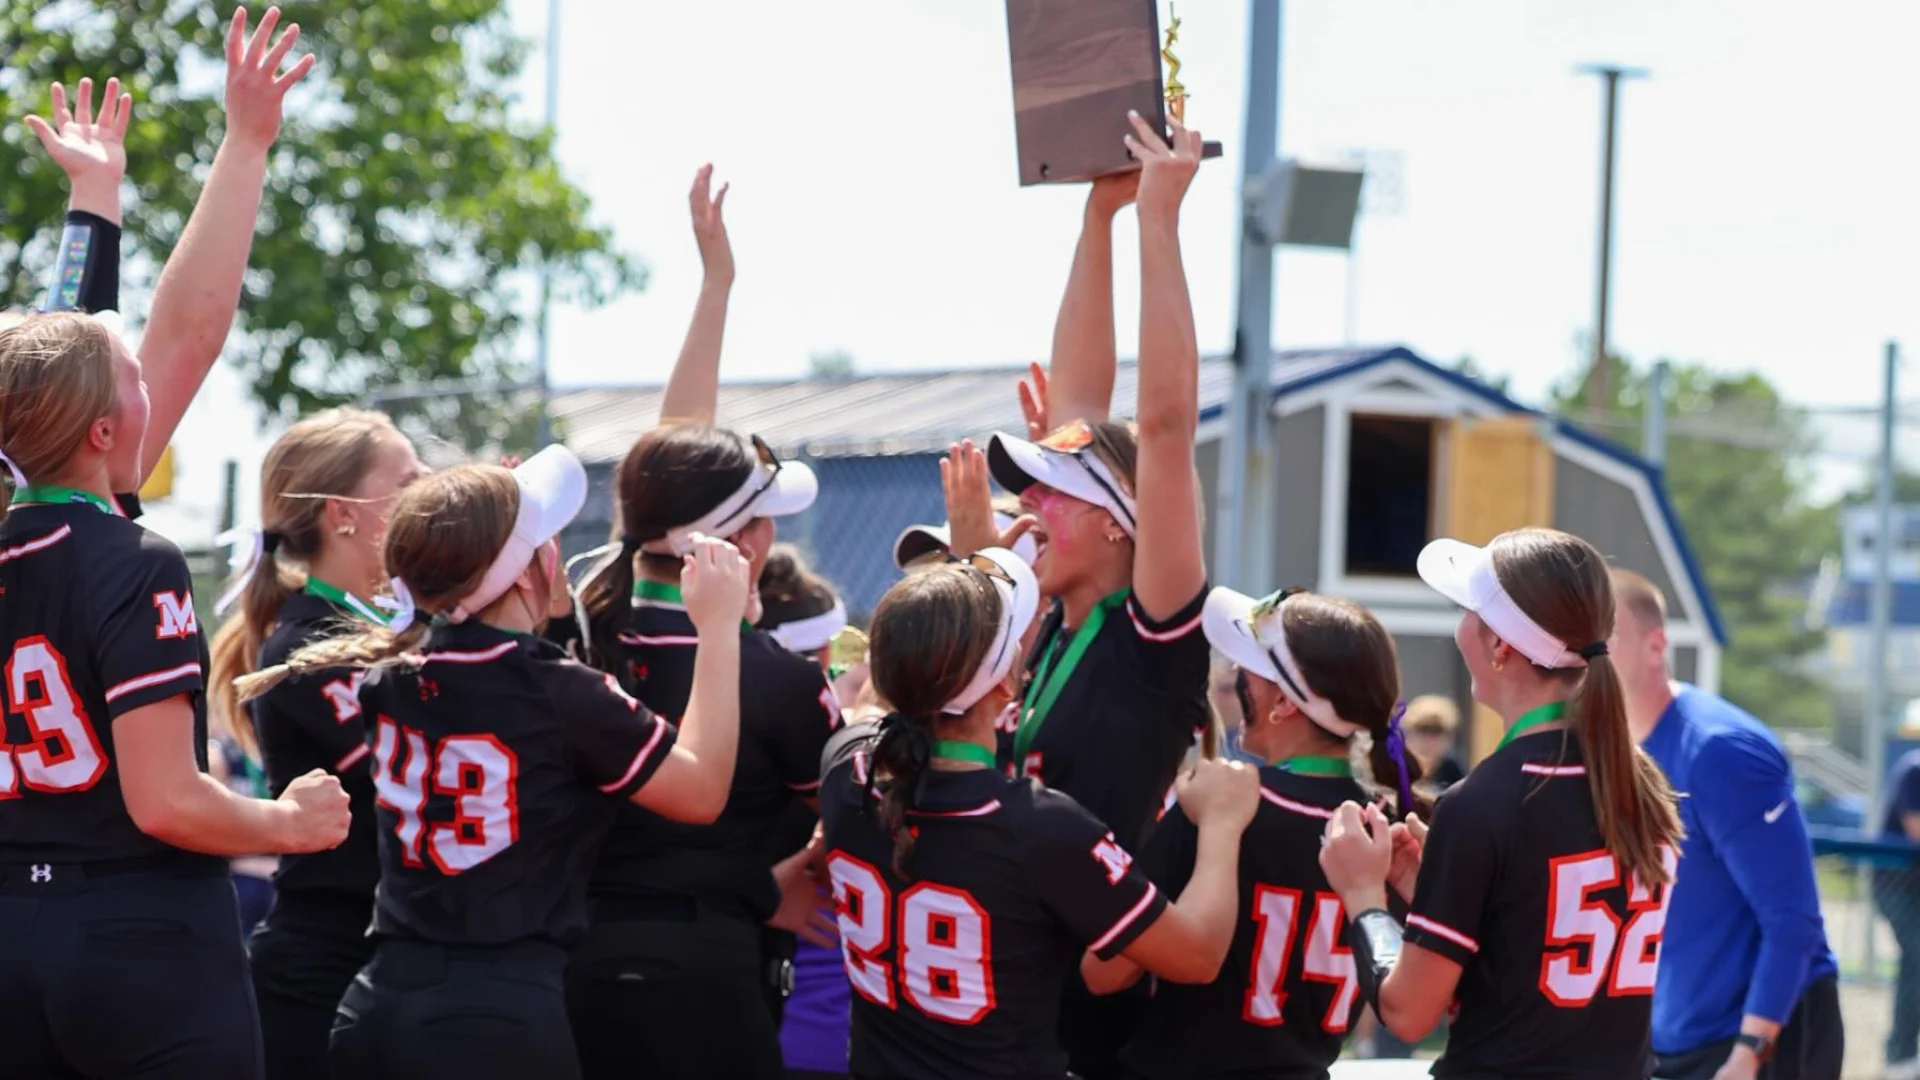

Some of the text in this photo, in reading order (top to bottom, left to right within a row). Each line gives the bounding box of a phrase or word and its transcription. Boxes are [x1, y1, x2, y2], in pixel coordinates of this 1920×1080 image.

[0, 634, 109, 797] 3
[373, 713, 519, 876] 43
[826, 848, 996, 1025] 28
[1242, 881, 1360, 1033] 14
[1539, 844, 1678, 1007] 52
